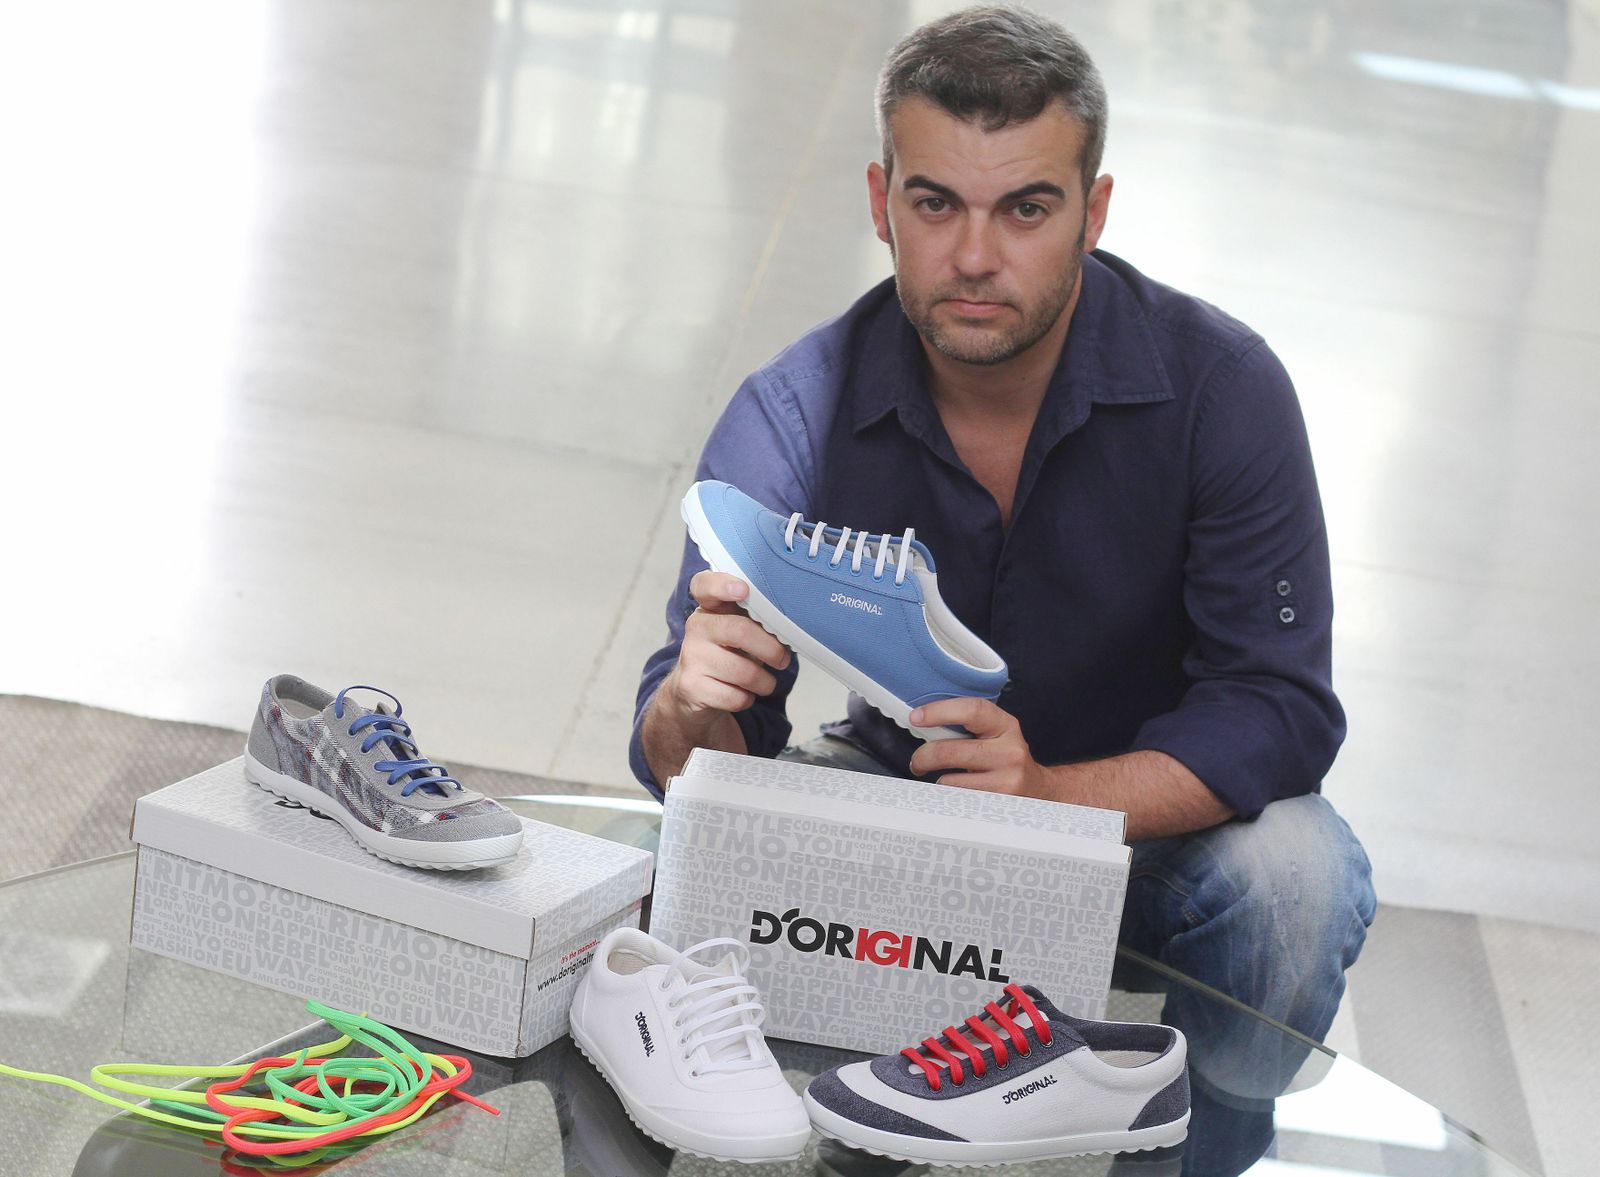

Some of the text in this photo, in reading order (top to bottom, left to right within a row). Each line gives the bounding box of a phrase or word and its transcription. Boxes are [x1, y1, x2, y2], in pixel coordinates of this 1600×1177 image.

[672, 808, 707, 822] NOS
[675, 798, 708, 811] FLASH
[707, 804, 793, 837] STYLE
[662, 818, 788, 861] RITMO
[792, 819, 917, 846] COLOR CHIC FLASH
[697, 848, 732, 860] COOL
[789, 831, 854, 859] YOU
[880, 842, 914, 856] NOS
[914, 839, 1001, 870] STYLE
[701, 857, 732, 874] WE
[732, 854, 786, 883] ON
[789, 850, 869, 874] GLOBAL
[870, 852, 996, 894] RITMO
[999, 852, 1125, 878] COLOR CHIC FLASH
[153, 856, 256, 909] RITMO
[674, 881, 712, 895] SALTA
[747, 881, 783, 894] BASIC
[786, 863, 902, 895] HAPPINES
[905, 883, 940, 895] COOL
[998, 865, 1060, 891] YOU
[1087, 874, 1123, 888] NOS
[153, 896, 172, 911] ON
[182, 890, 210, 905] COOL
[708, 887, 745, 906] YO
[746, 890, 782, 904] COOL
[783, 879, 872, 910] REBEL
[870, 892, 894, 905] ON
[906, 891, 940, 908] WE
[939, 888, 994, 916] ON
[996, 883, 1077, 906] GLOBAL
[185, 899, 210, 918] WE
[210, 898, 256, 932] ON
[258, 899, 326, 930] GLOBAL
[652, 894, 740, 920] FASHION
[895, 904, 954, 924] VIVE!!
[993, 896, 1110, 928] HAPPINES
[162, 920, 193, 937] SALTA
[173, 910, 224, 937] VIVE!!
[880, 915, 917, 928] SALTA
[954, 925, 988, 937] COOL
[955, 914, 990, 927] BASIC
[990, 911, 1080, 943] REBEL
[1076, 924, 1100, 937] ON
[191, 930, 221, 953] YO
[223, 937, 252, 953] COOL
[256, 912, 355, 955] HAPPINES
[327, 908, 437, 963] RITMO
[988, 931, 1058, 958] WAY
[145, 933, 218, 966] FASHION
[254, 928, 331, 968] REBEL
[358, 943, 388, 958] COOL
[750, 908, 1009, 983] D'ORIGINAL
[222, 948, 252, 976] EU
[254, 948, 314, 983] WAY
[328, 950, 349, 965] ON
[361, 952, 387, 972] WE
[388, 951, 436, 986] ON
[438, 951, 509, 983] GLOBAL
[1018, 955, 1066, 972] CORRE
[307, 972, 329, 987] GO!
[338, 974, 371, 992] SALTA
[350, 964, 403, 991] VIVE!!
[774, 960, 852, 983] GLOBAL
[854, 962, 979, 1003] RITMO
[1029, 969, 1074, 986] CHIC
[1073, 975, 1106, 989] FLASH
[280, 977, 320, 997] CORRE
[369, 984, 400, 1007] YO
[403, 980, 434, 997] BASIC
[769, 971, 886, 1004] HAPPINES
[888, 991, 923, 1003] COOL
[1069, 985, 1104, 1000] NOS
[320, 986, 397, 1021] FASHION
[402, 991, 432, 1008] COOL
[434, 981, 514, 1023] REBEL
[767, 987, 857, 1018] REBEL
[853, 1000, 878, 1014] ON
[892, 1000, 923, 1016] WE
[400, 1001, 432, 1031] EU
[433, 1002, 494, 1037] WAY
[764, 1005, 835, 1034] WAY
[460, 1031, 502, 1052] CORRE
